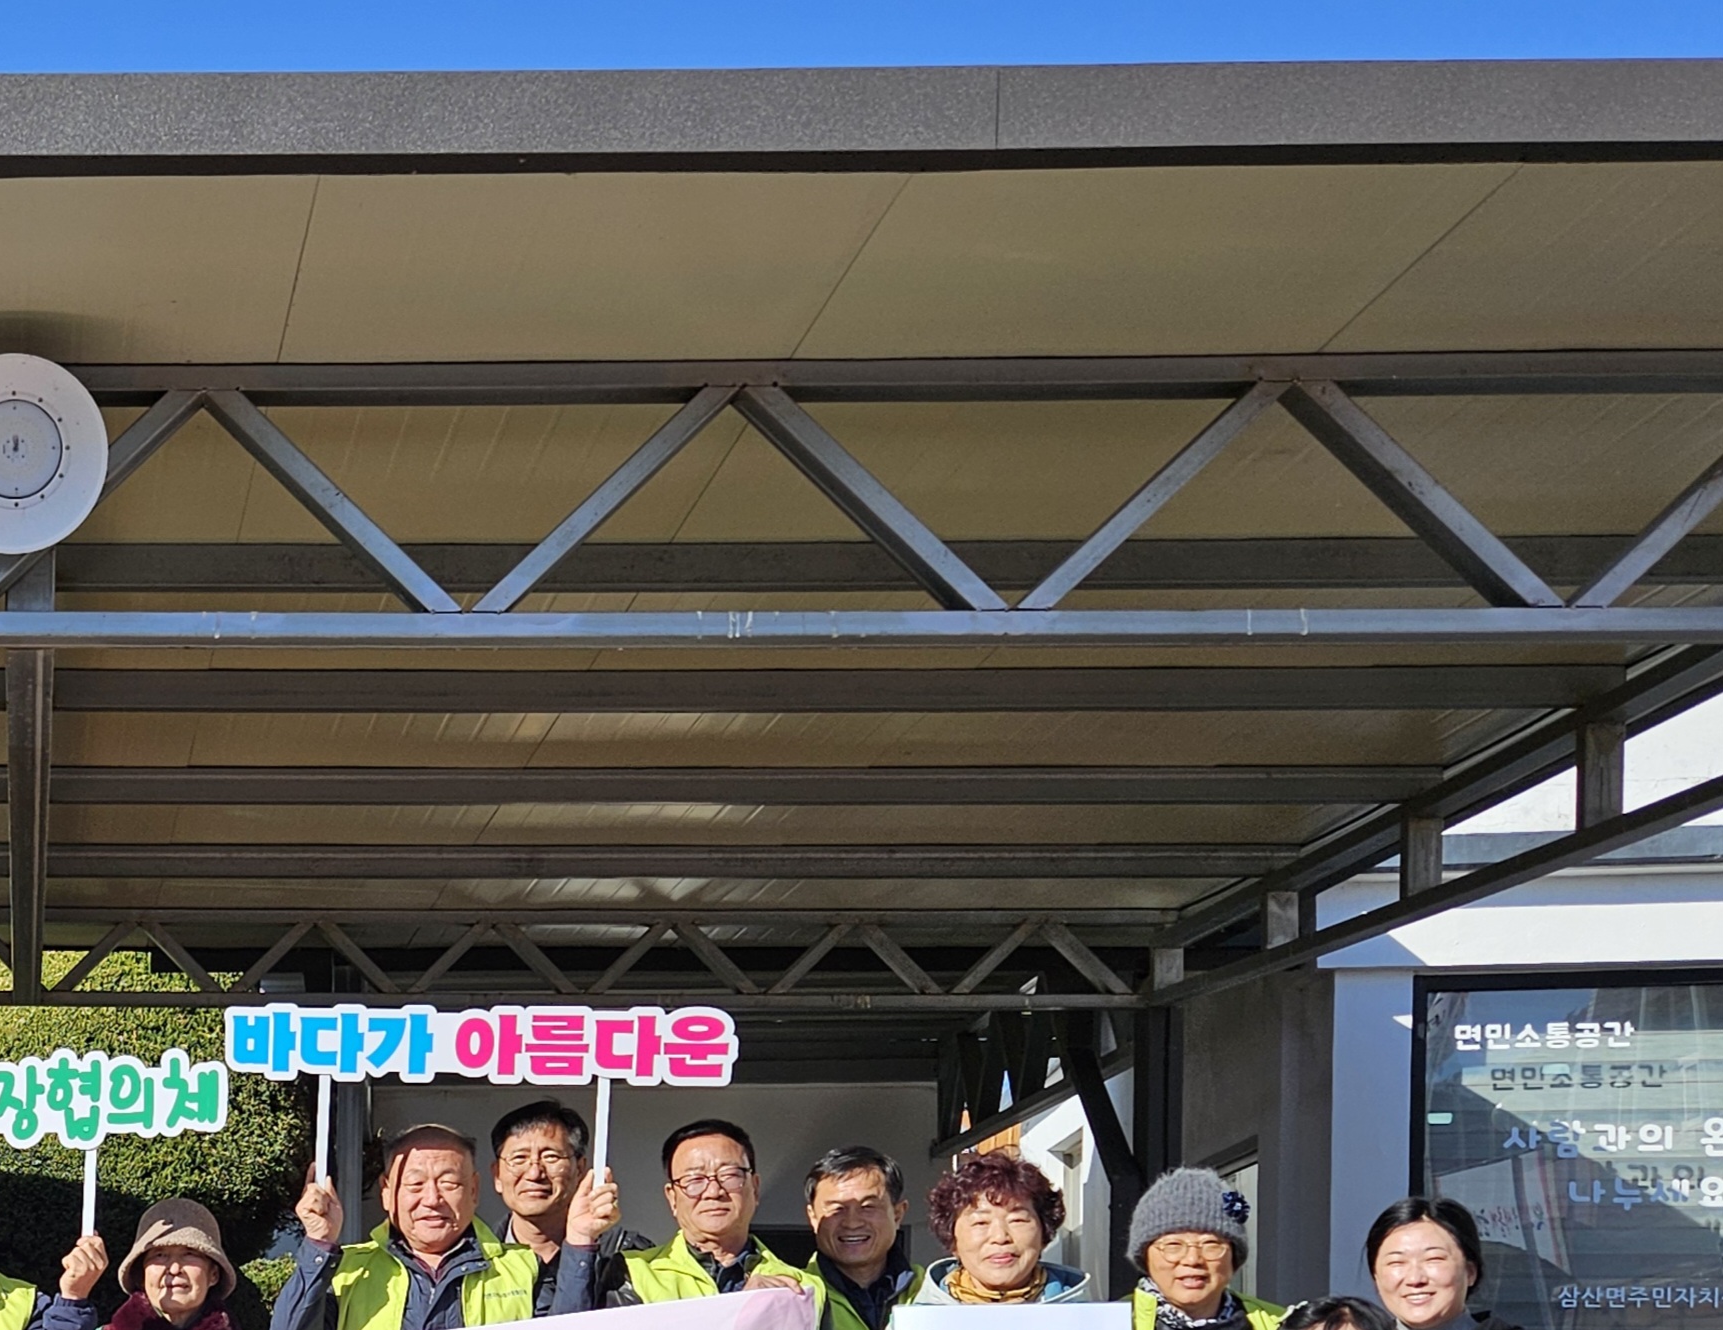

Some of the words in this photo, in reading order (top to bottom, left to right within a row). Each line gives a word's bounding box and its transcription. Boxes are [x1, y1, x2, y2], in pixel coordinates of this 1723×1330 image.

[233, 1010, 433, 1077] 바다가
[455, 1013, 731, 1081] 아름다운
[1454, 1021, 1635, 1051] 면민소통공간
[1503, 1119, 1673, 1159] 사람과의
[1569, 1176, 1723, 1212] 나누세요
[1558, 1284, 1723, 1309] 삼산면주민자치
